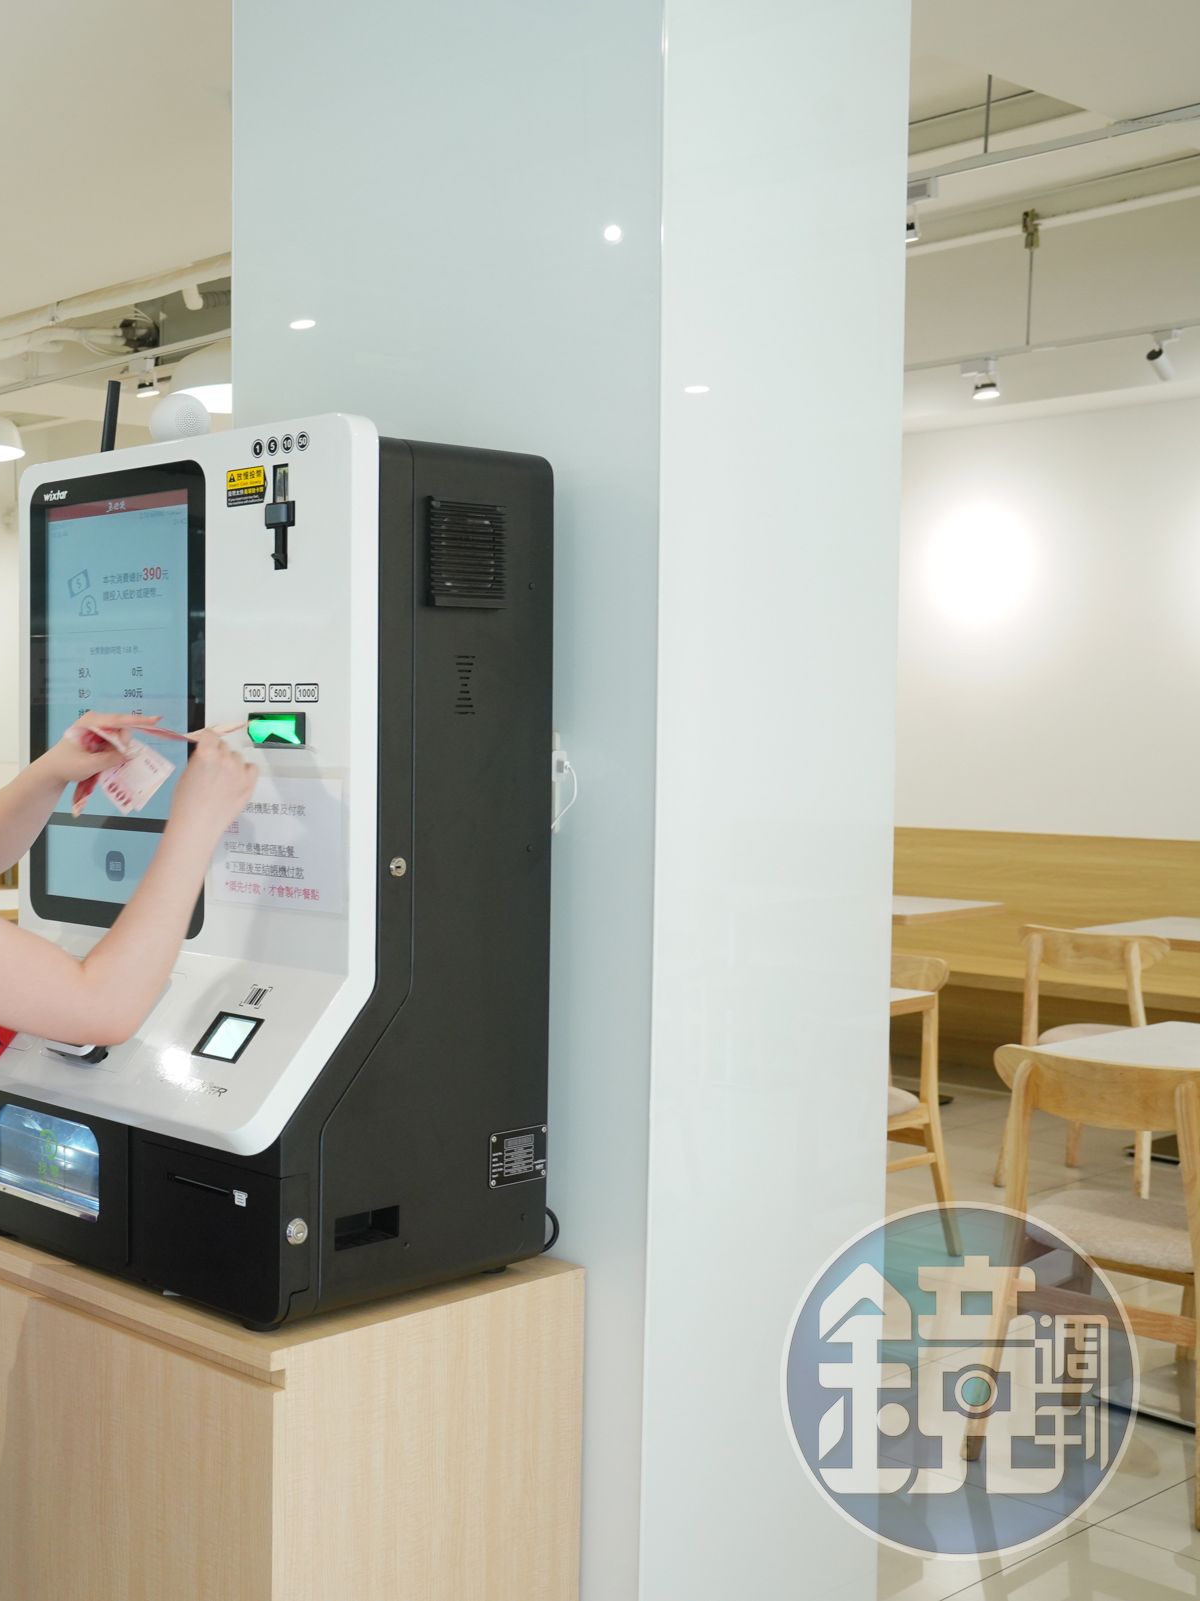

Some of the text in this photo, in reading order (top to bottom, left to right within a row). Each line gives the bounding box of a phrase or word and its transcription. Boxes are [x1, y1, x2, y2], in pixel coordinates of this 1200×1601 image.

[123, 687, 144, 699] 390元
[248, 688, 316, 698] 100 500 1000
